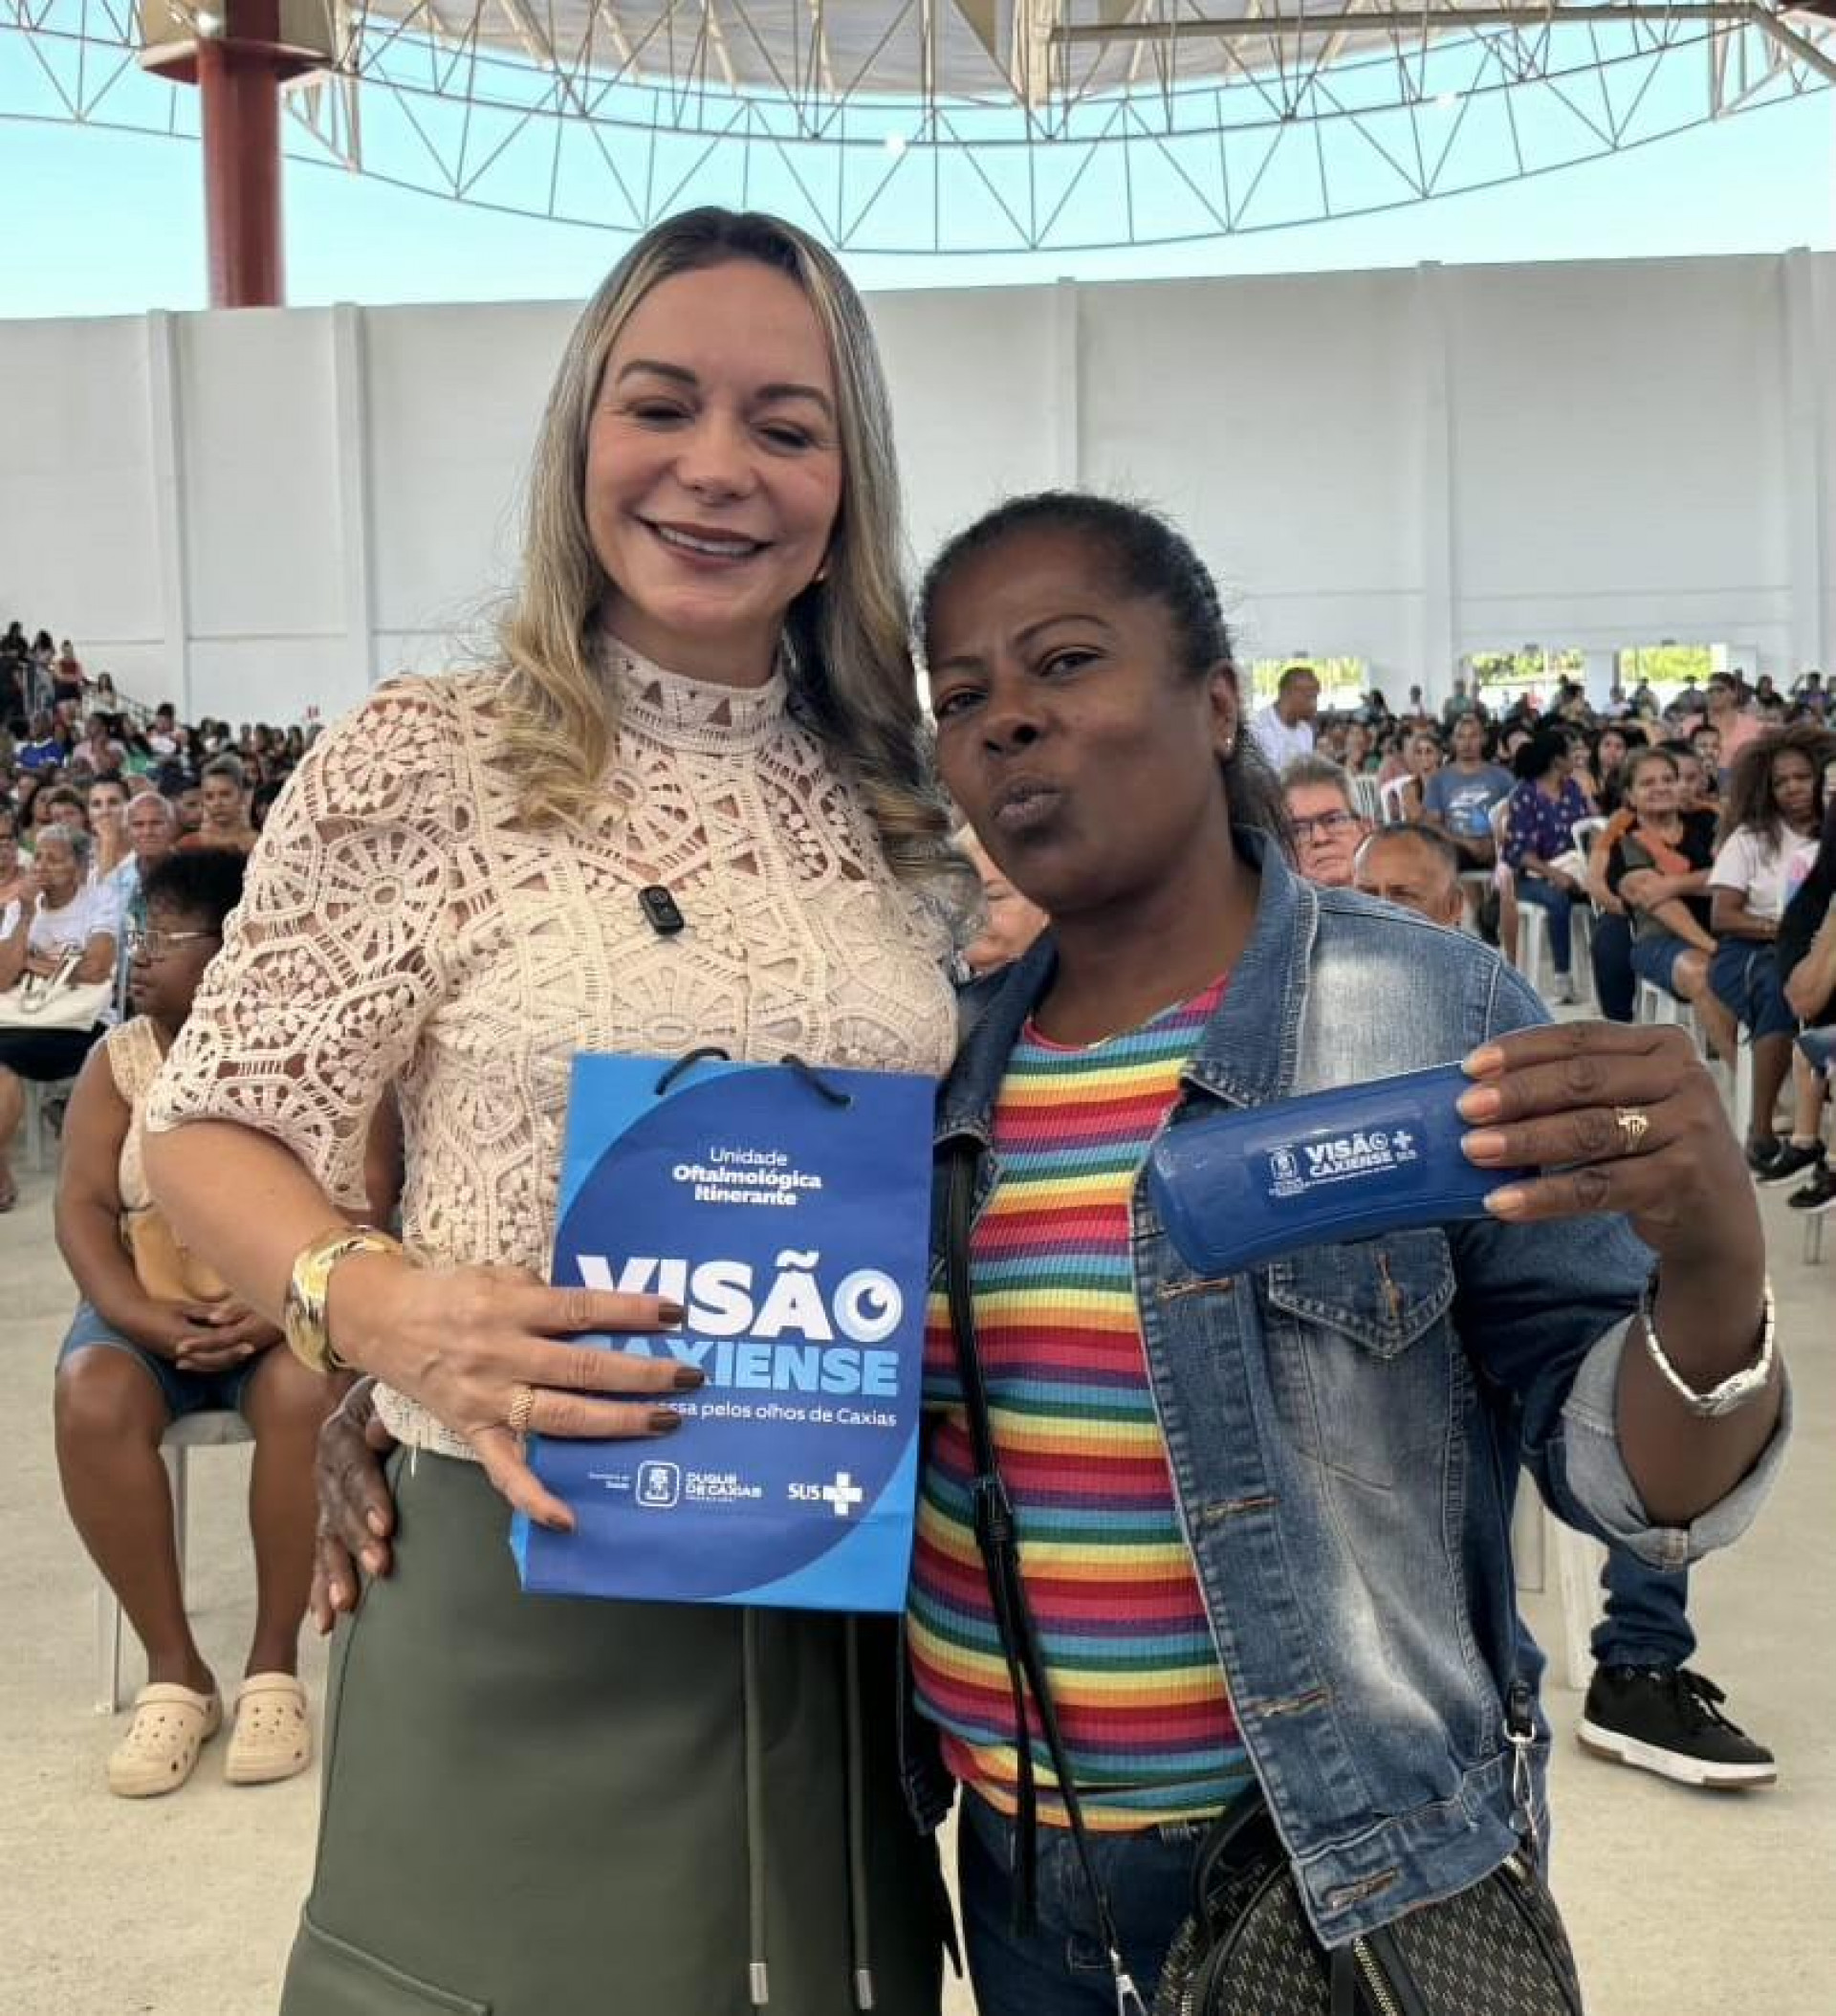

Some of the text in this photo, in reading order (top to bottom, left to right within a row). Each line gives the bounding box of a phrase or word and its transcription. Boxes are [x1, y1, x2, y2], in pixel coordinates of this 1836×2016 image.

[710, 1146, 788, 1166] Unidade
[672, 1165, 822, 1190] Oftalmológica
[694, 1183, 797, 1206] Itinerante
[578, 1335, 900, 1397] XIENSE
[701, 1400, 751, 1420] pelos
[756, 1402, 805, 1421] olhos
[809, 1404, 833, 1422] de
[837, 1407, 897, 1428] Caxias
[787, 1482, 820, 1501] SUS
